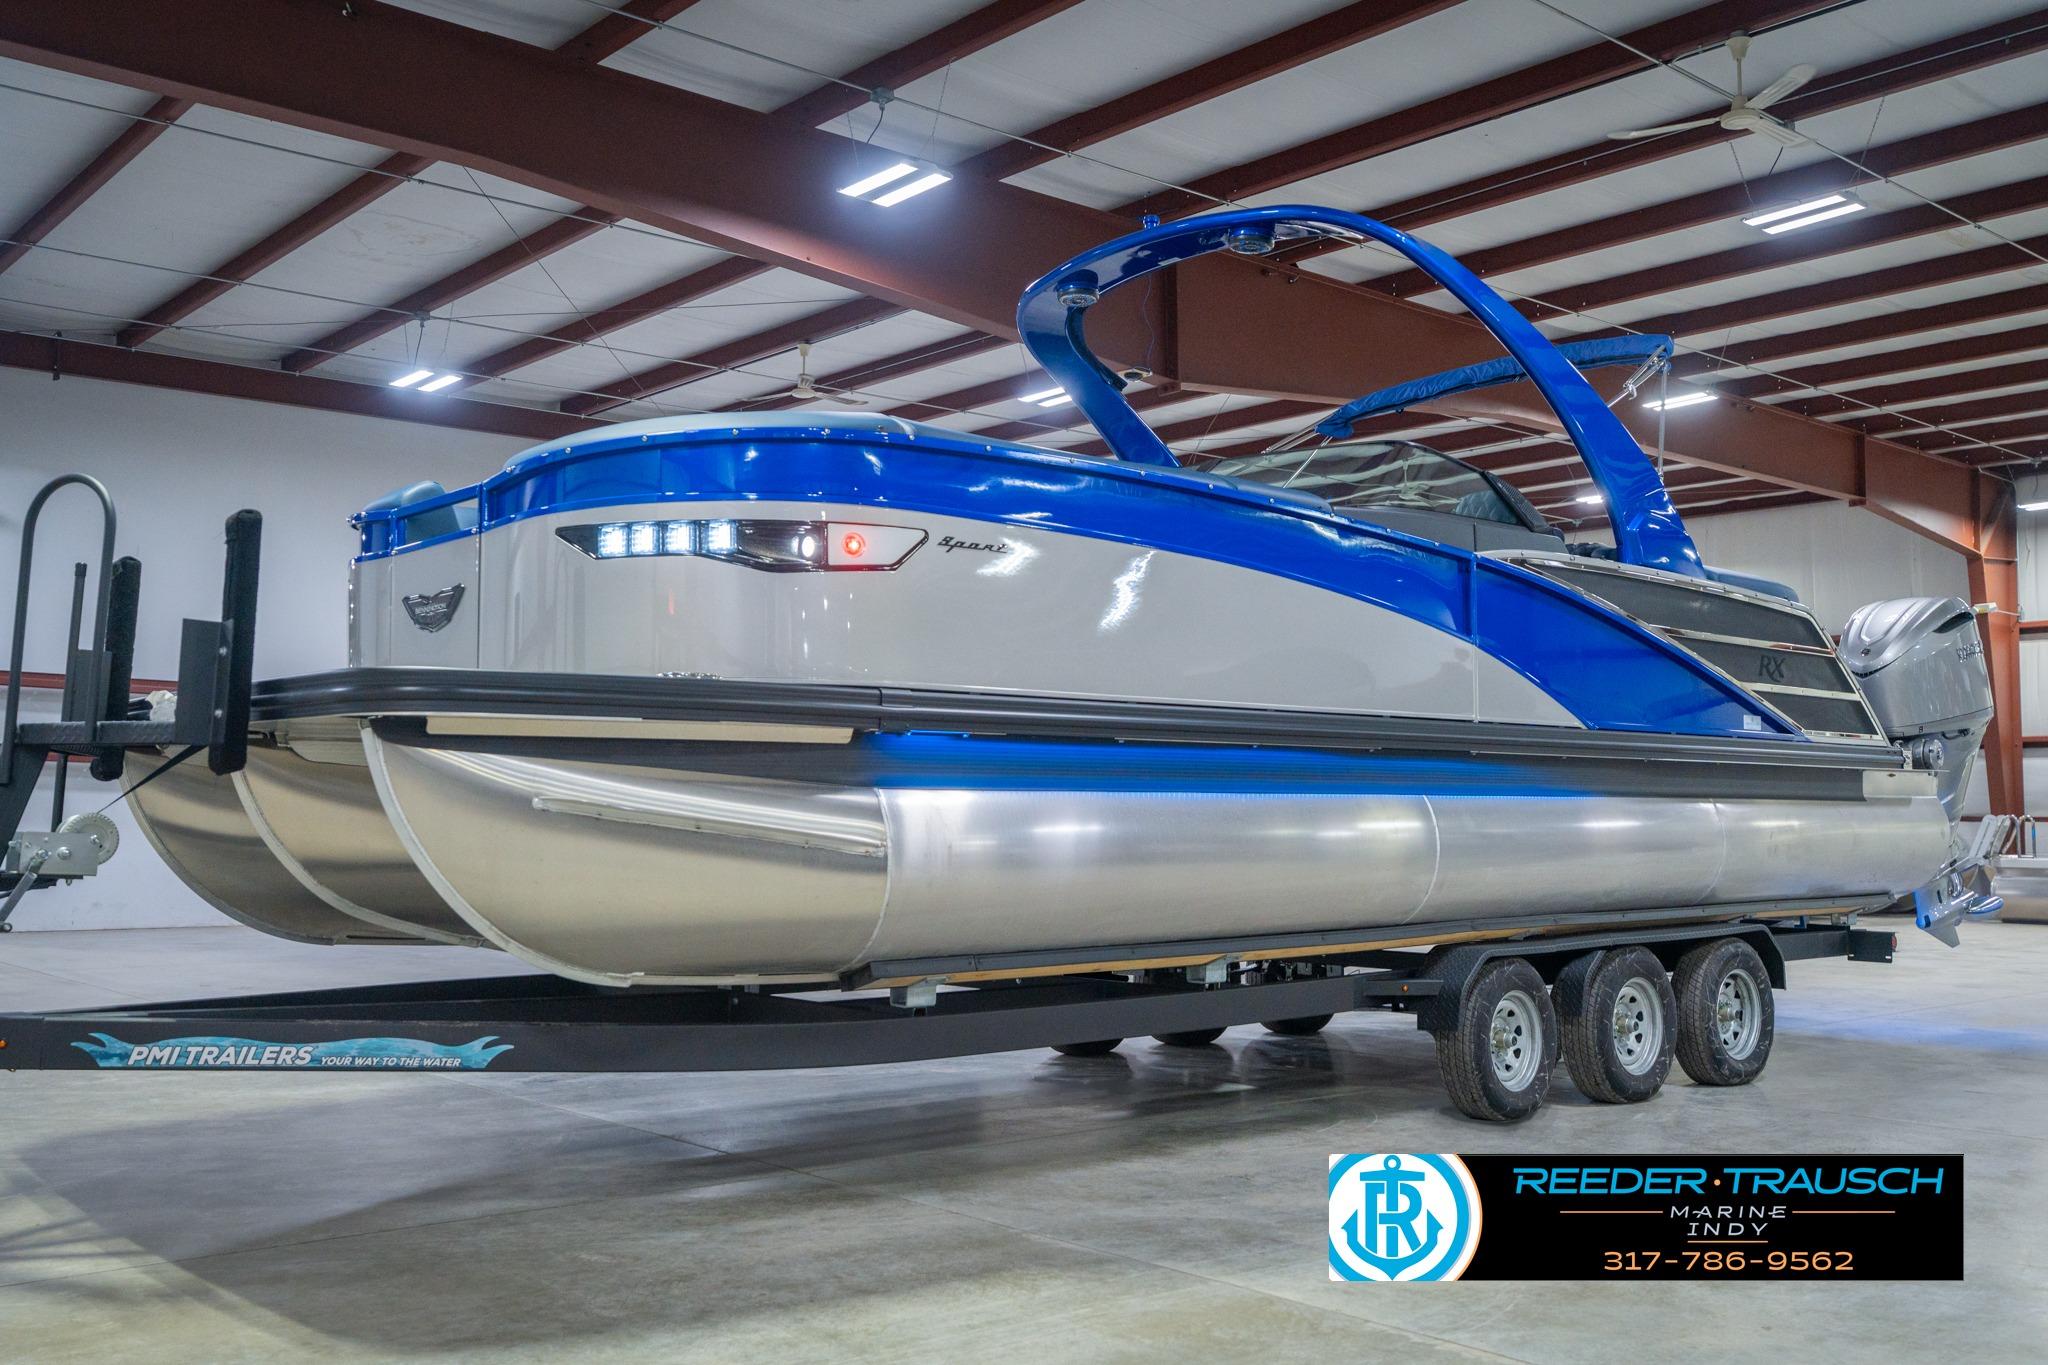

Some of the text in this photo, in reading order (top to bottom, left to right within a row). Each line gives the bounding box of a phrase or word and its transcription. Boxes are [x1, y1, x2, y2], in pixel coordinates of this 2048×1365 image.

[937, 535, 1008, 554] Sport
[1758, 654, 1786, 682] RX
[127, 1046, 314, 1066] PMI TRAILERS
[321, 1055, 462, 1068] YOUR WAY TO THE WATER
